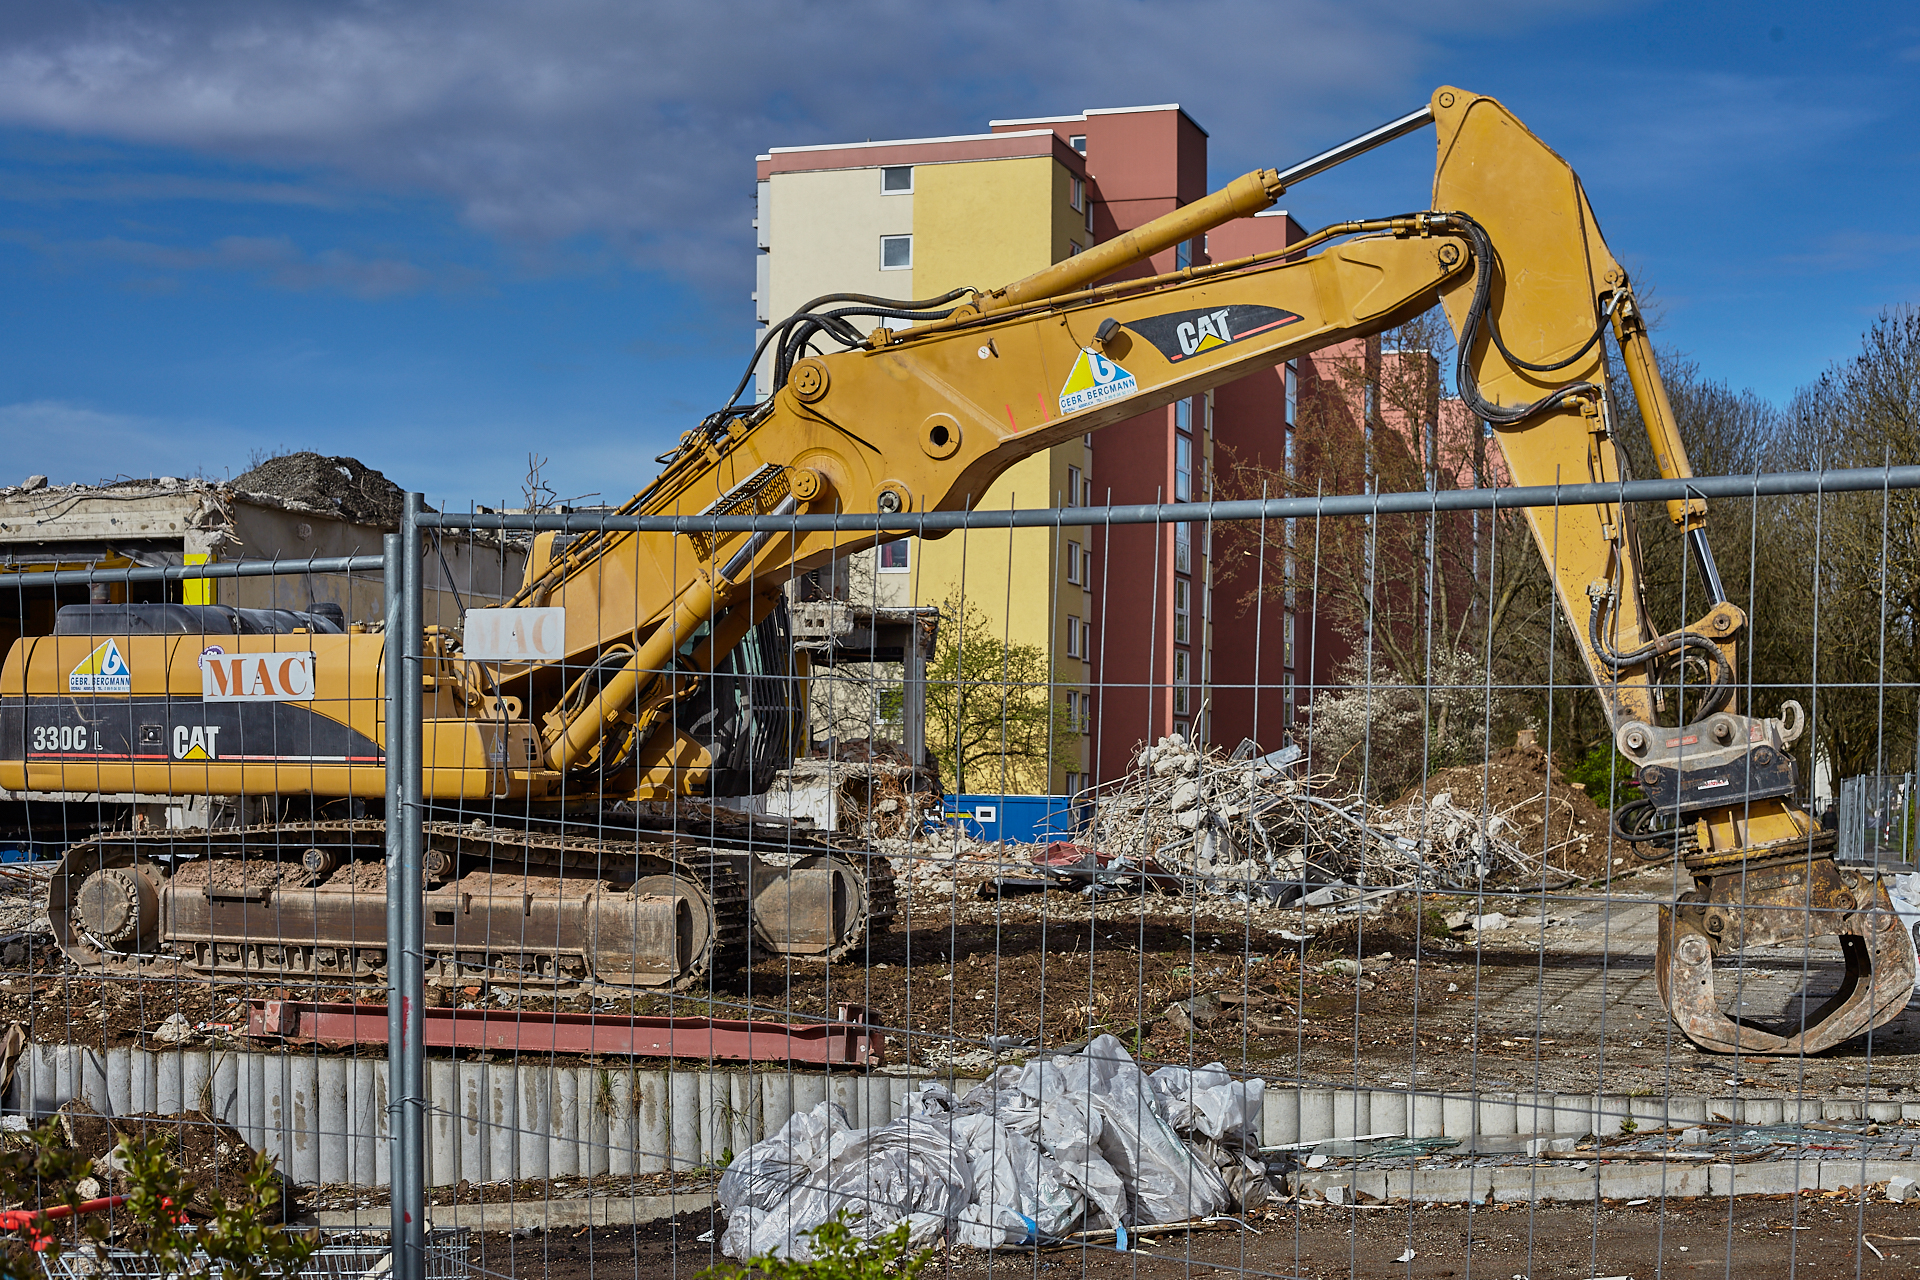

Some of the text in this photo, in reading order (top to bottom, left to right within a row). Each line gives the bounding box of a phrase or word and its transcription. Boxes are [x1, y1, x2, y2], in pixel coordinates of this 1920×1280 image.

[1176, 309, 1232, 355] CAT
[1060, 394, 1086, 409] GEBR.
[1086, 378, 1135, 400] BERGMANN
[205, 656, 308, 697] MAC
[33, 725, 87, 751] 330C
[173, 725, 220, 760] CAT
